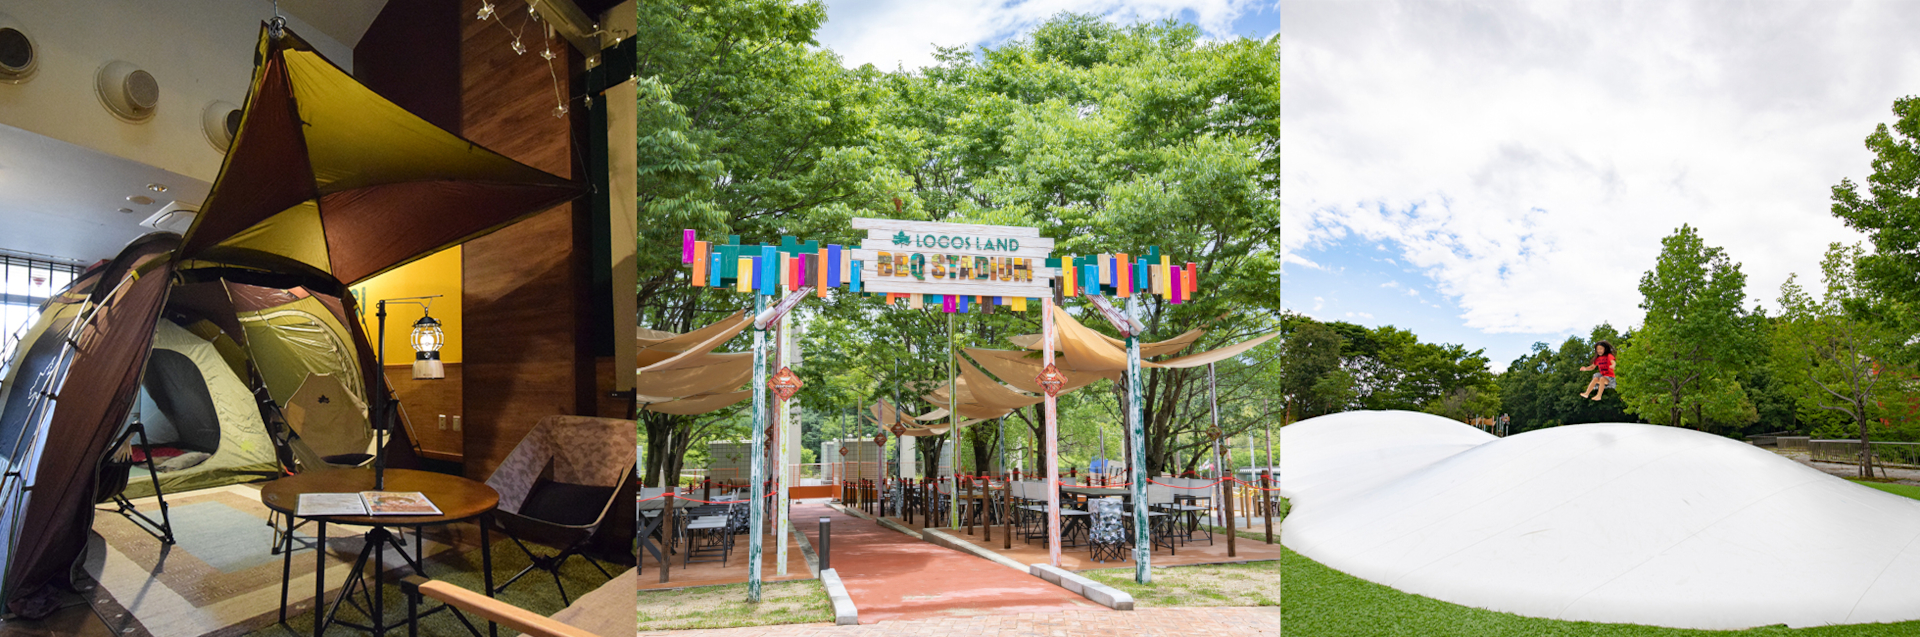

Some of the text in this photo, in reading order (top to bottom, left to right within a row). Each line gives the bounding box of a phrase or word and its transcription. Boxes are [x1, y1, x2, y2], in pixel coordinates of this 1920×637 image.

[917, 234, 1020, 252] LOGOS LAND
[877, 251, 1033, 282] BBQ STADIUM
